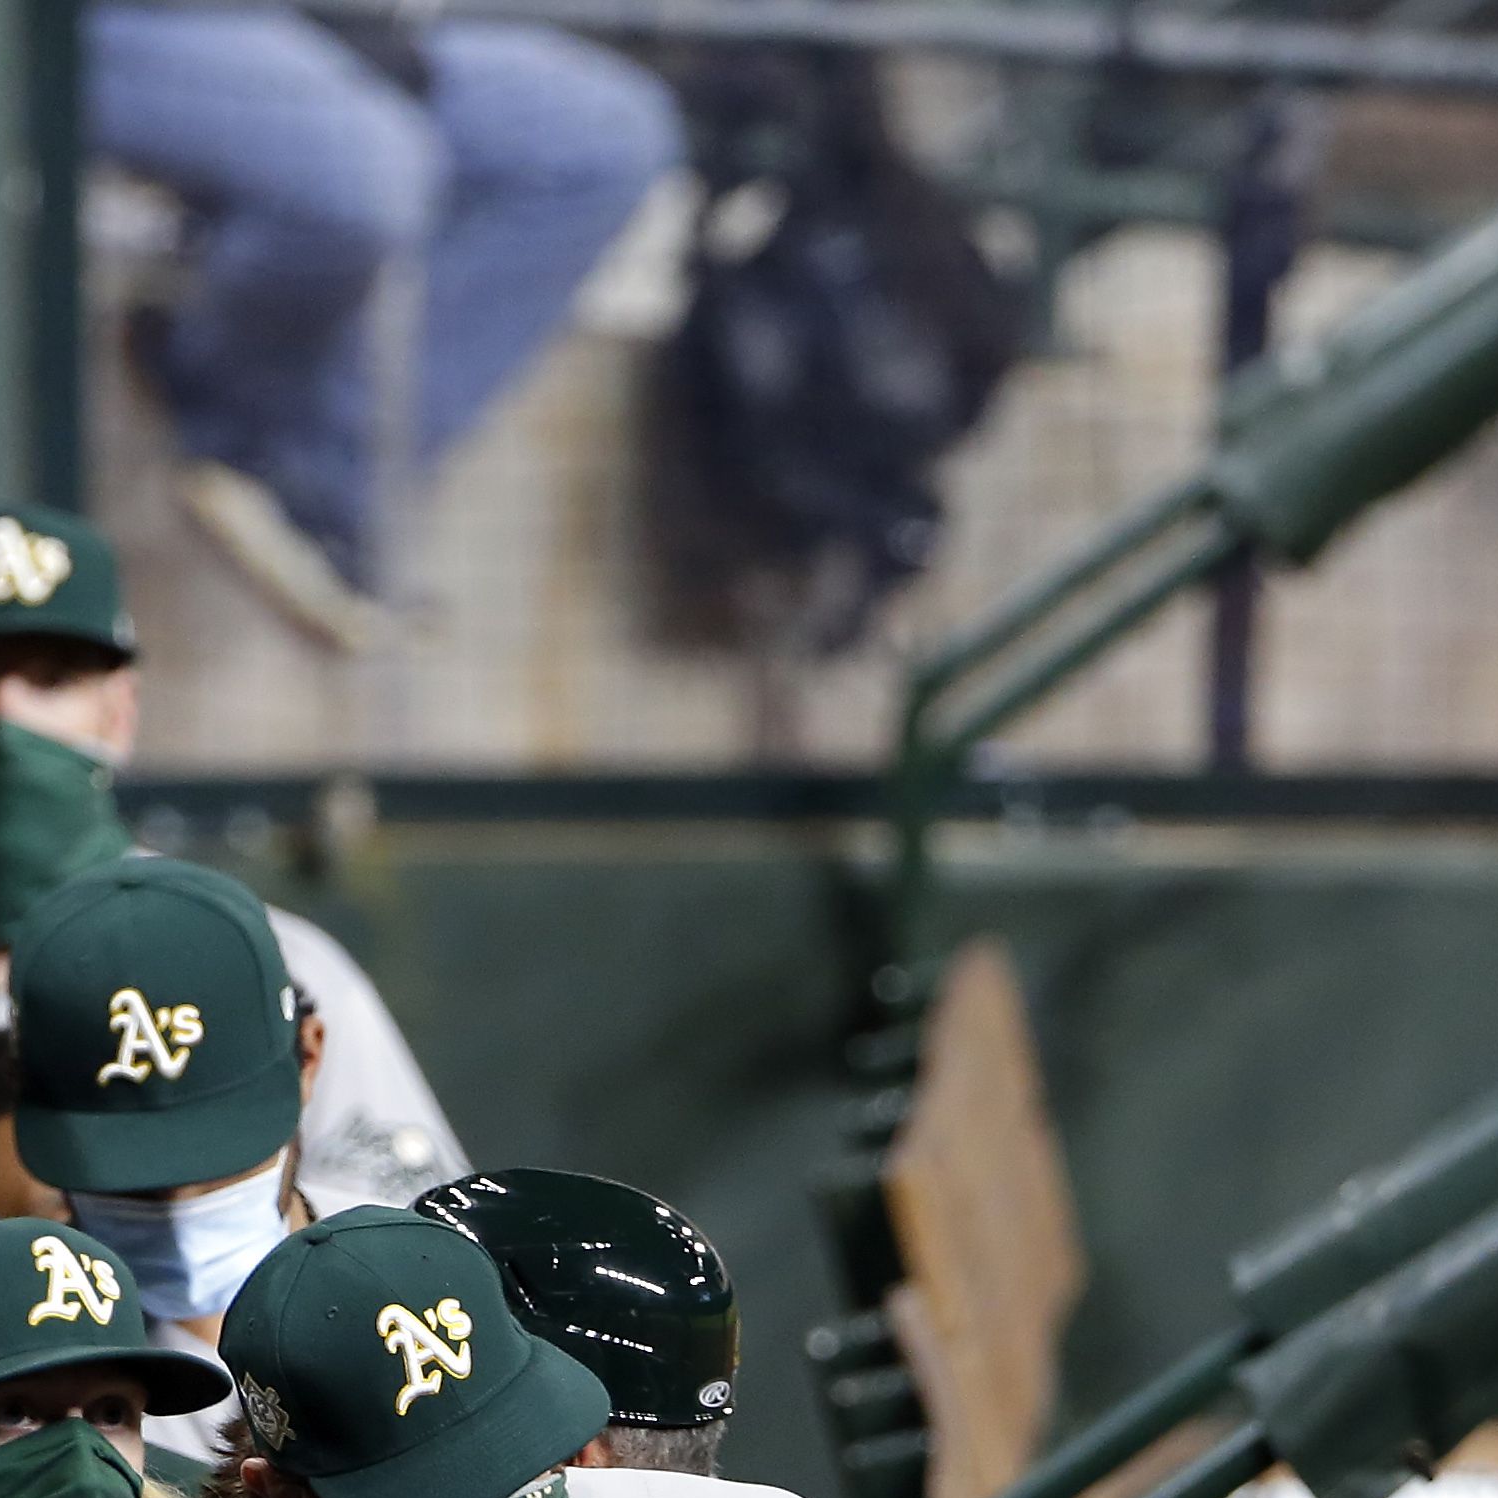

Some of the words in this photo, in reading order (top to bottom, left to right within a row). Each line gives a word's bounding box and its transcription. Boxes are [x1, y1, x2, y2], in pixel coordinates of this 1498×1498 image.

[95, 985, 205, 1086] A's
[26, 1234, 123, 1327] A's
[376, 1297, 474, 1416] A's
